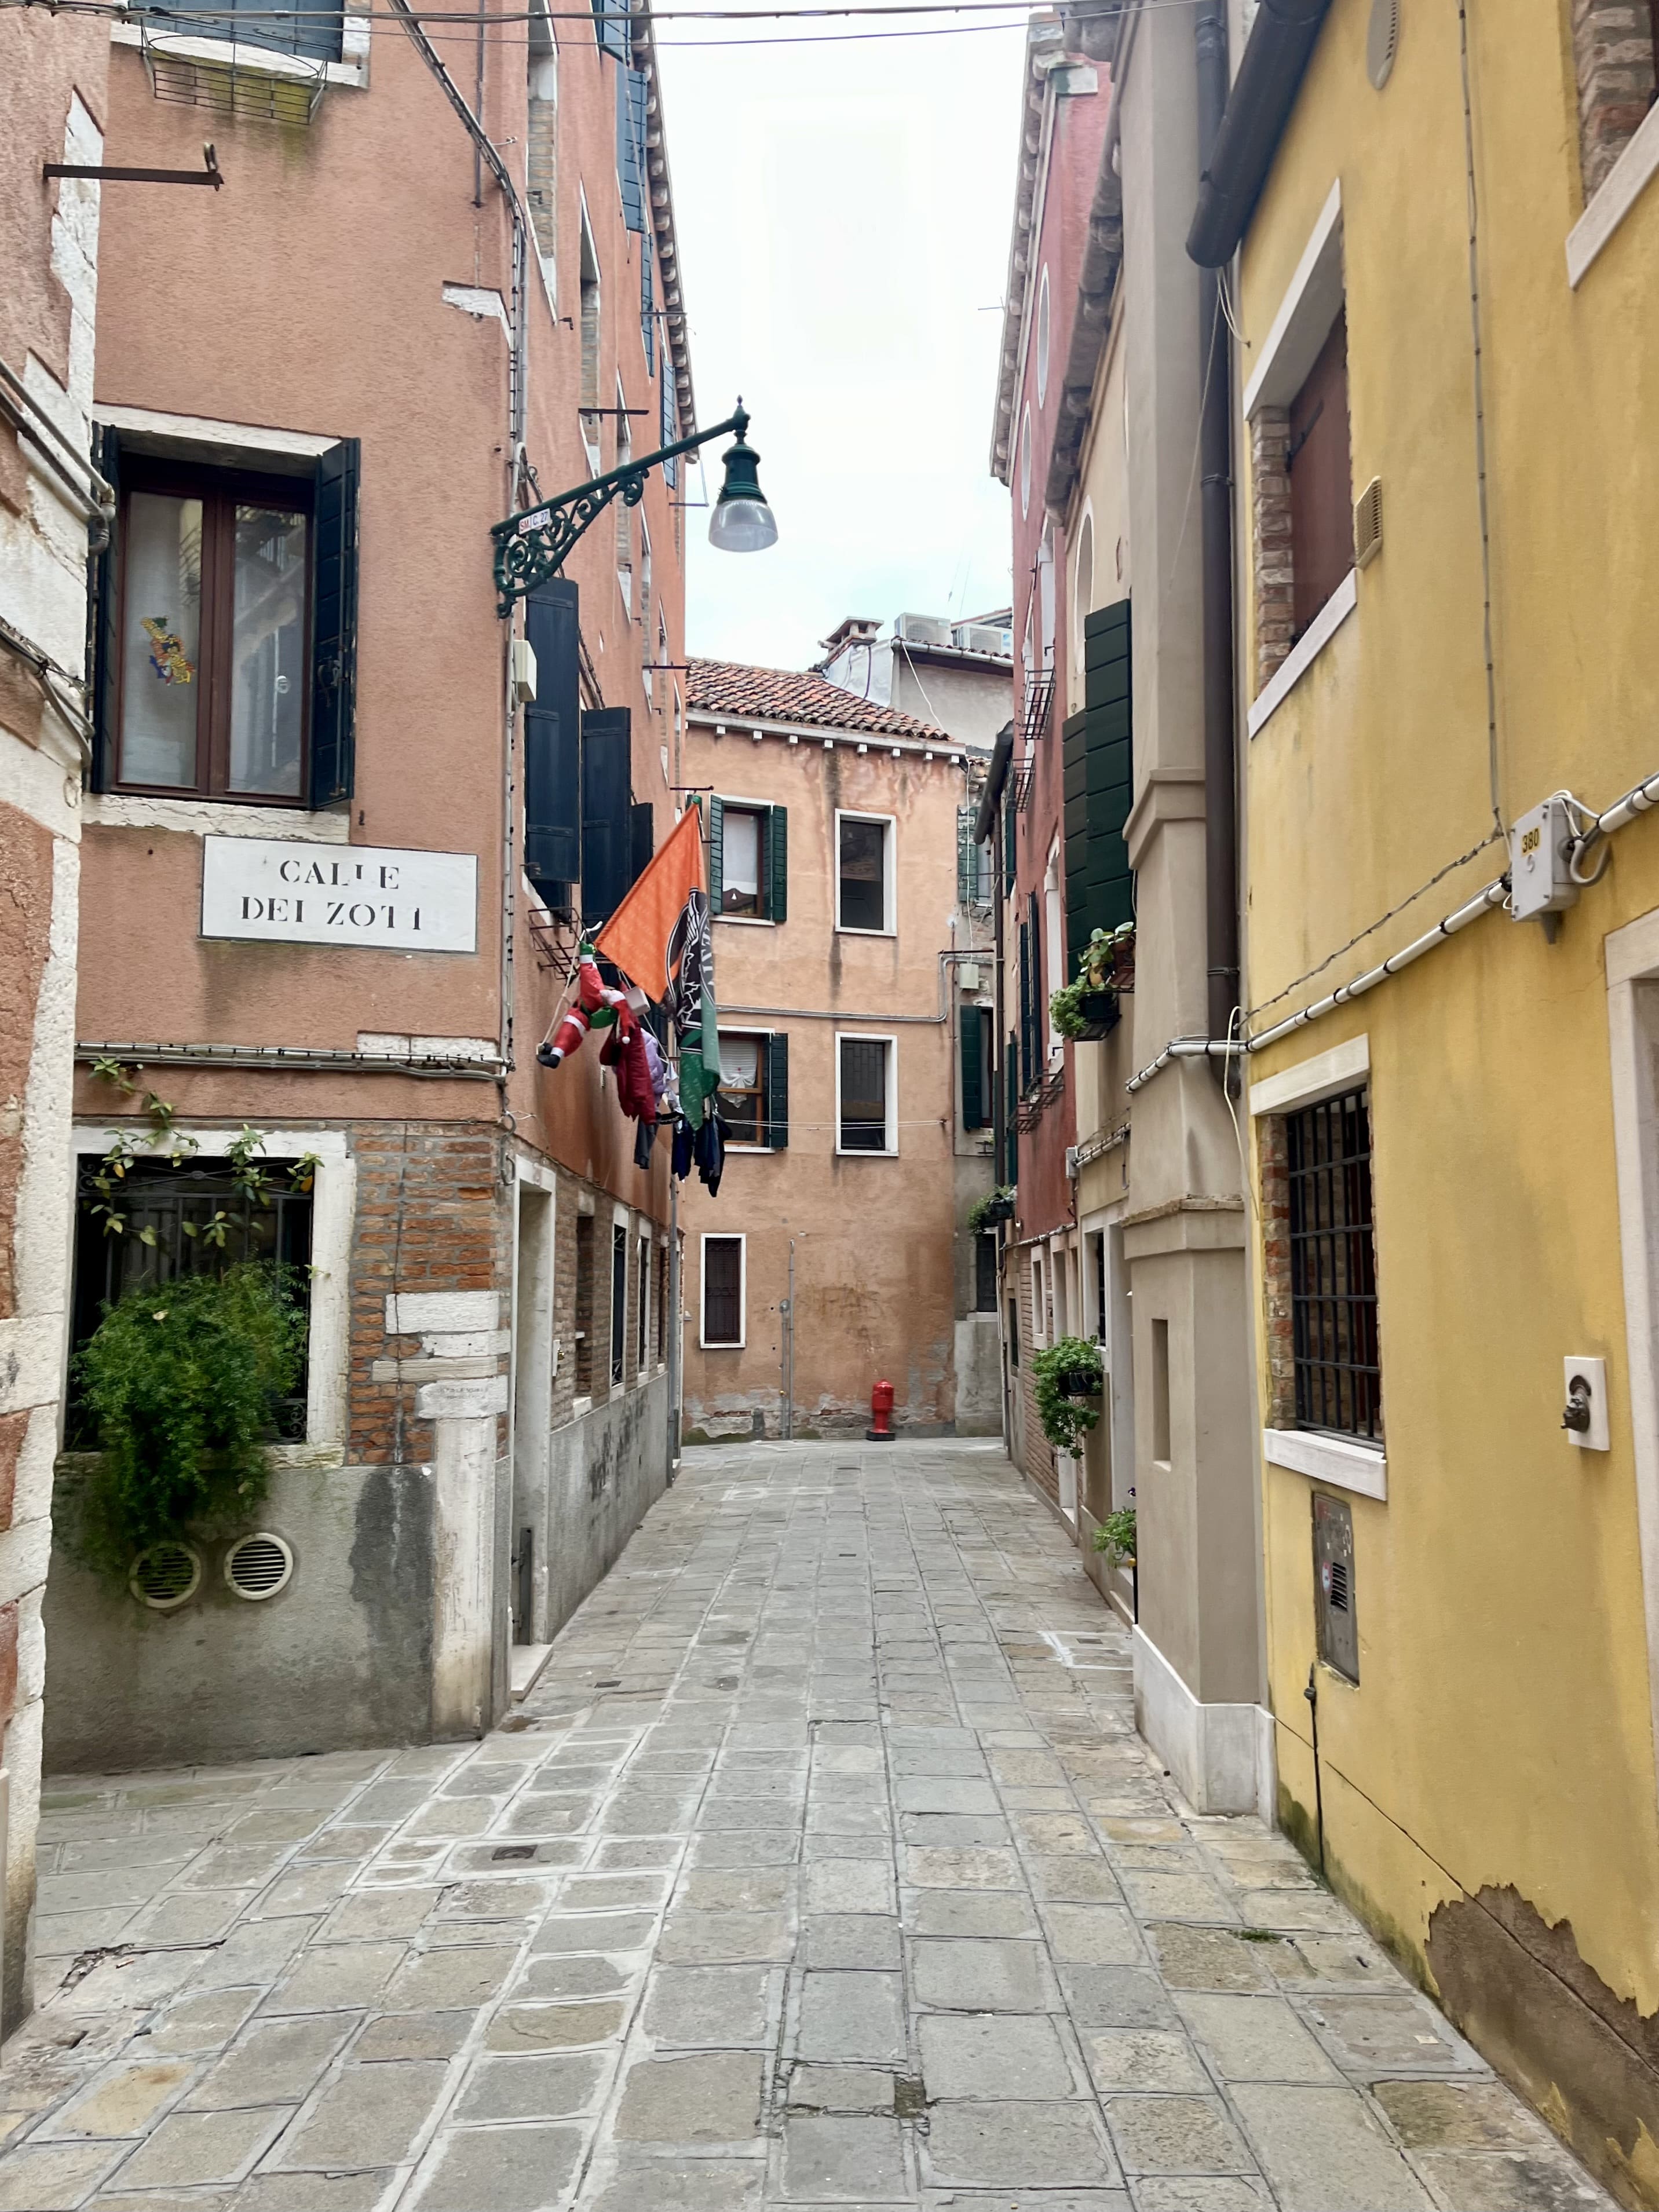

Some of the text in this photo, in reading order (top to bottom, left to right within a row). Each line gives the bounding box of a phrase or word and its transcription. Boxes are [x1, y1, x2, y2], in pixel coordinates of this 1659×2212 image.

[540, 511, 549, 523] 27
[1522, 827, 1540, 854] 380
[241, 896, 305, 923] DEI
